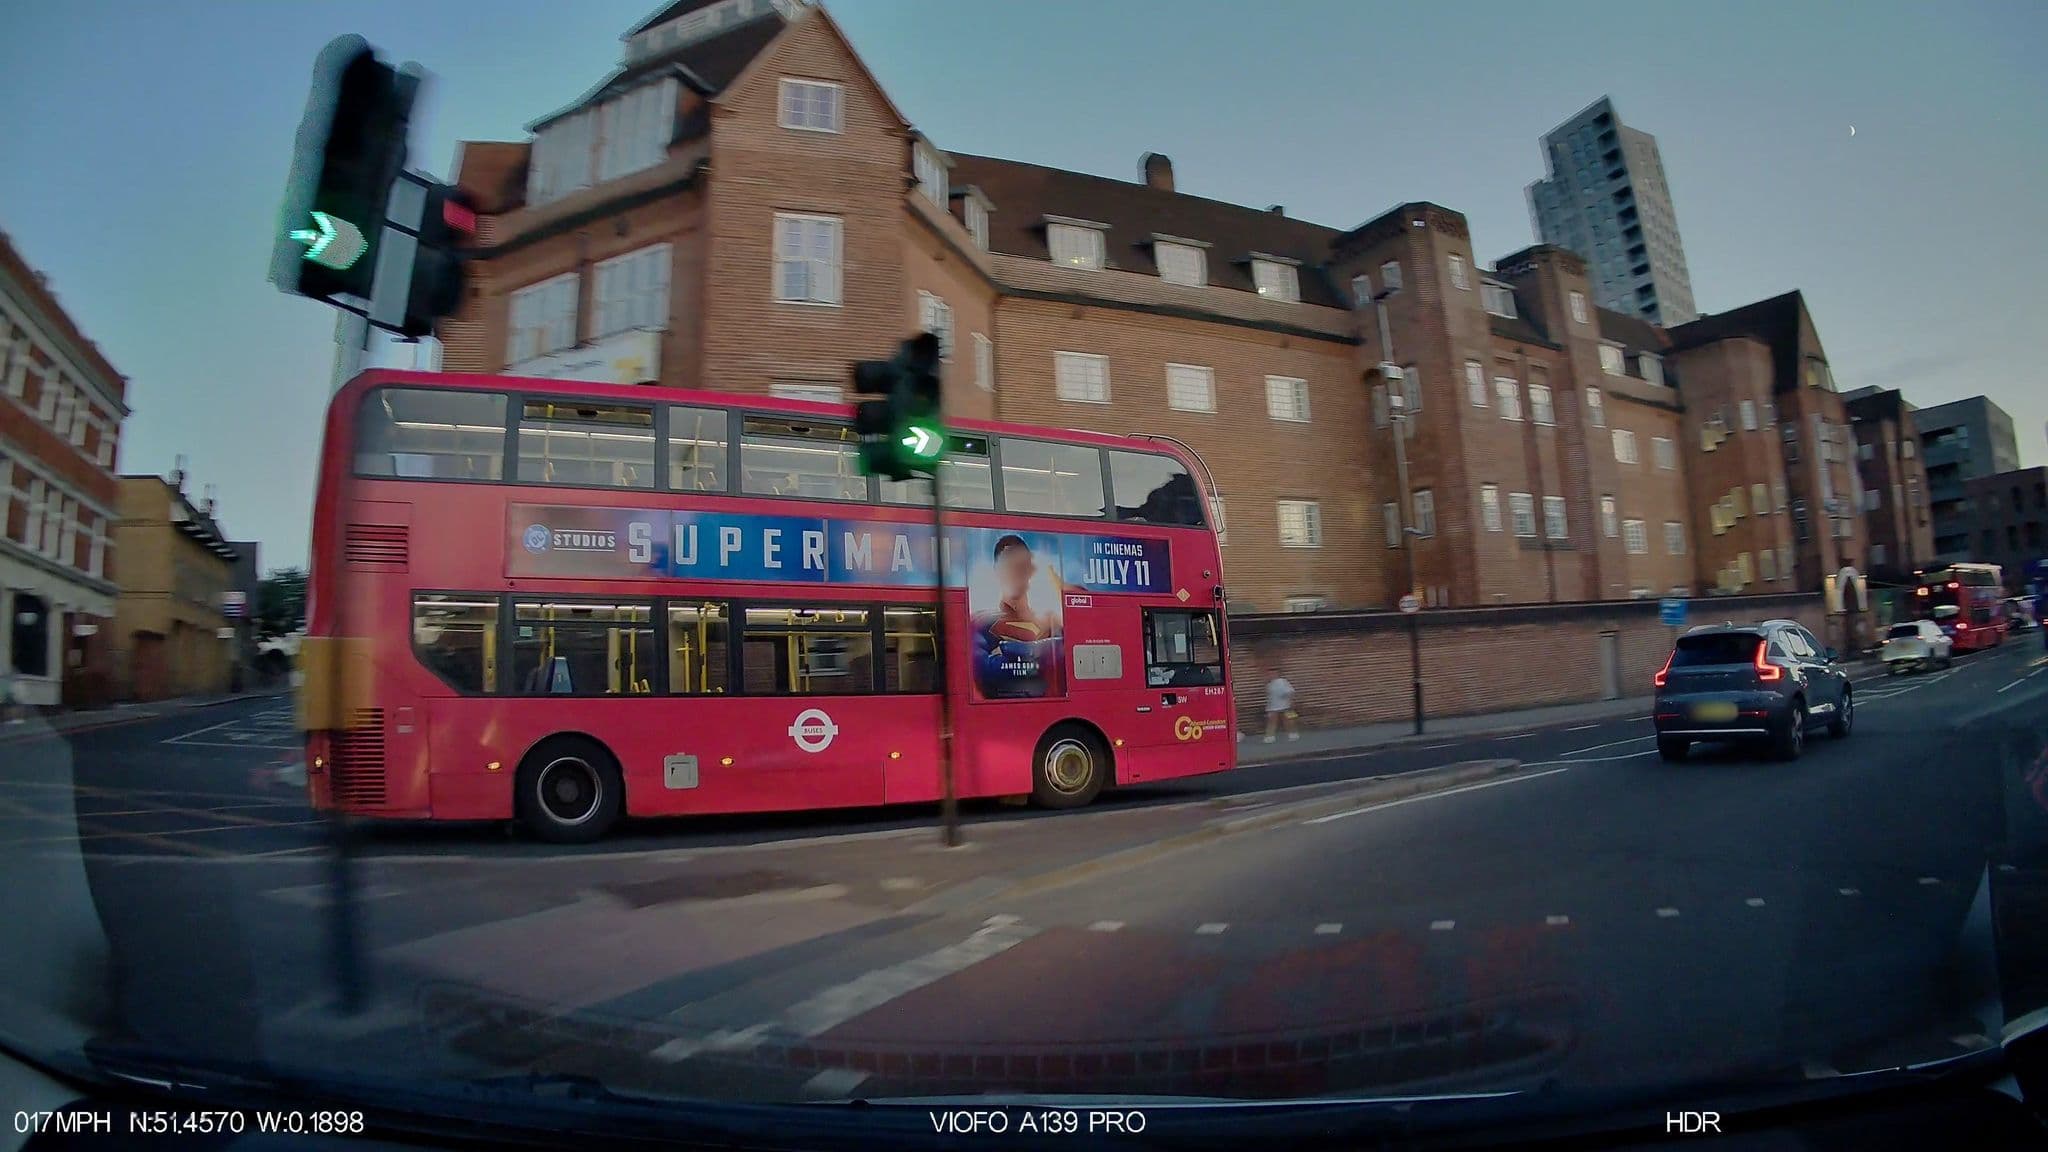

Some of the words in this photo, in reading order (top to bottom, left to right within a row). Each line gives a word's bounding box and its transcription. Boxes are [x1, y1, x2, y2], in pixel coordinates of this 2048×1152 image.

[553, 533, 616, 547] STUDIOS
[1093, 542, 1102, 554] IN
[1104, 543, 1143, 556] CINEMAS
[1083, 558, 1129, 585] JULY
[1134, 560, 1150, 586] 11
[1174, 715, 1203, 741] Go
